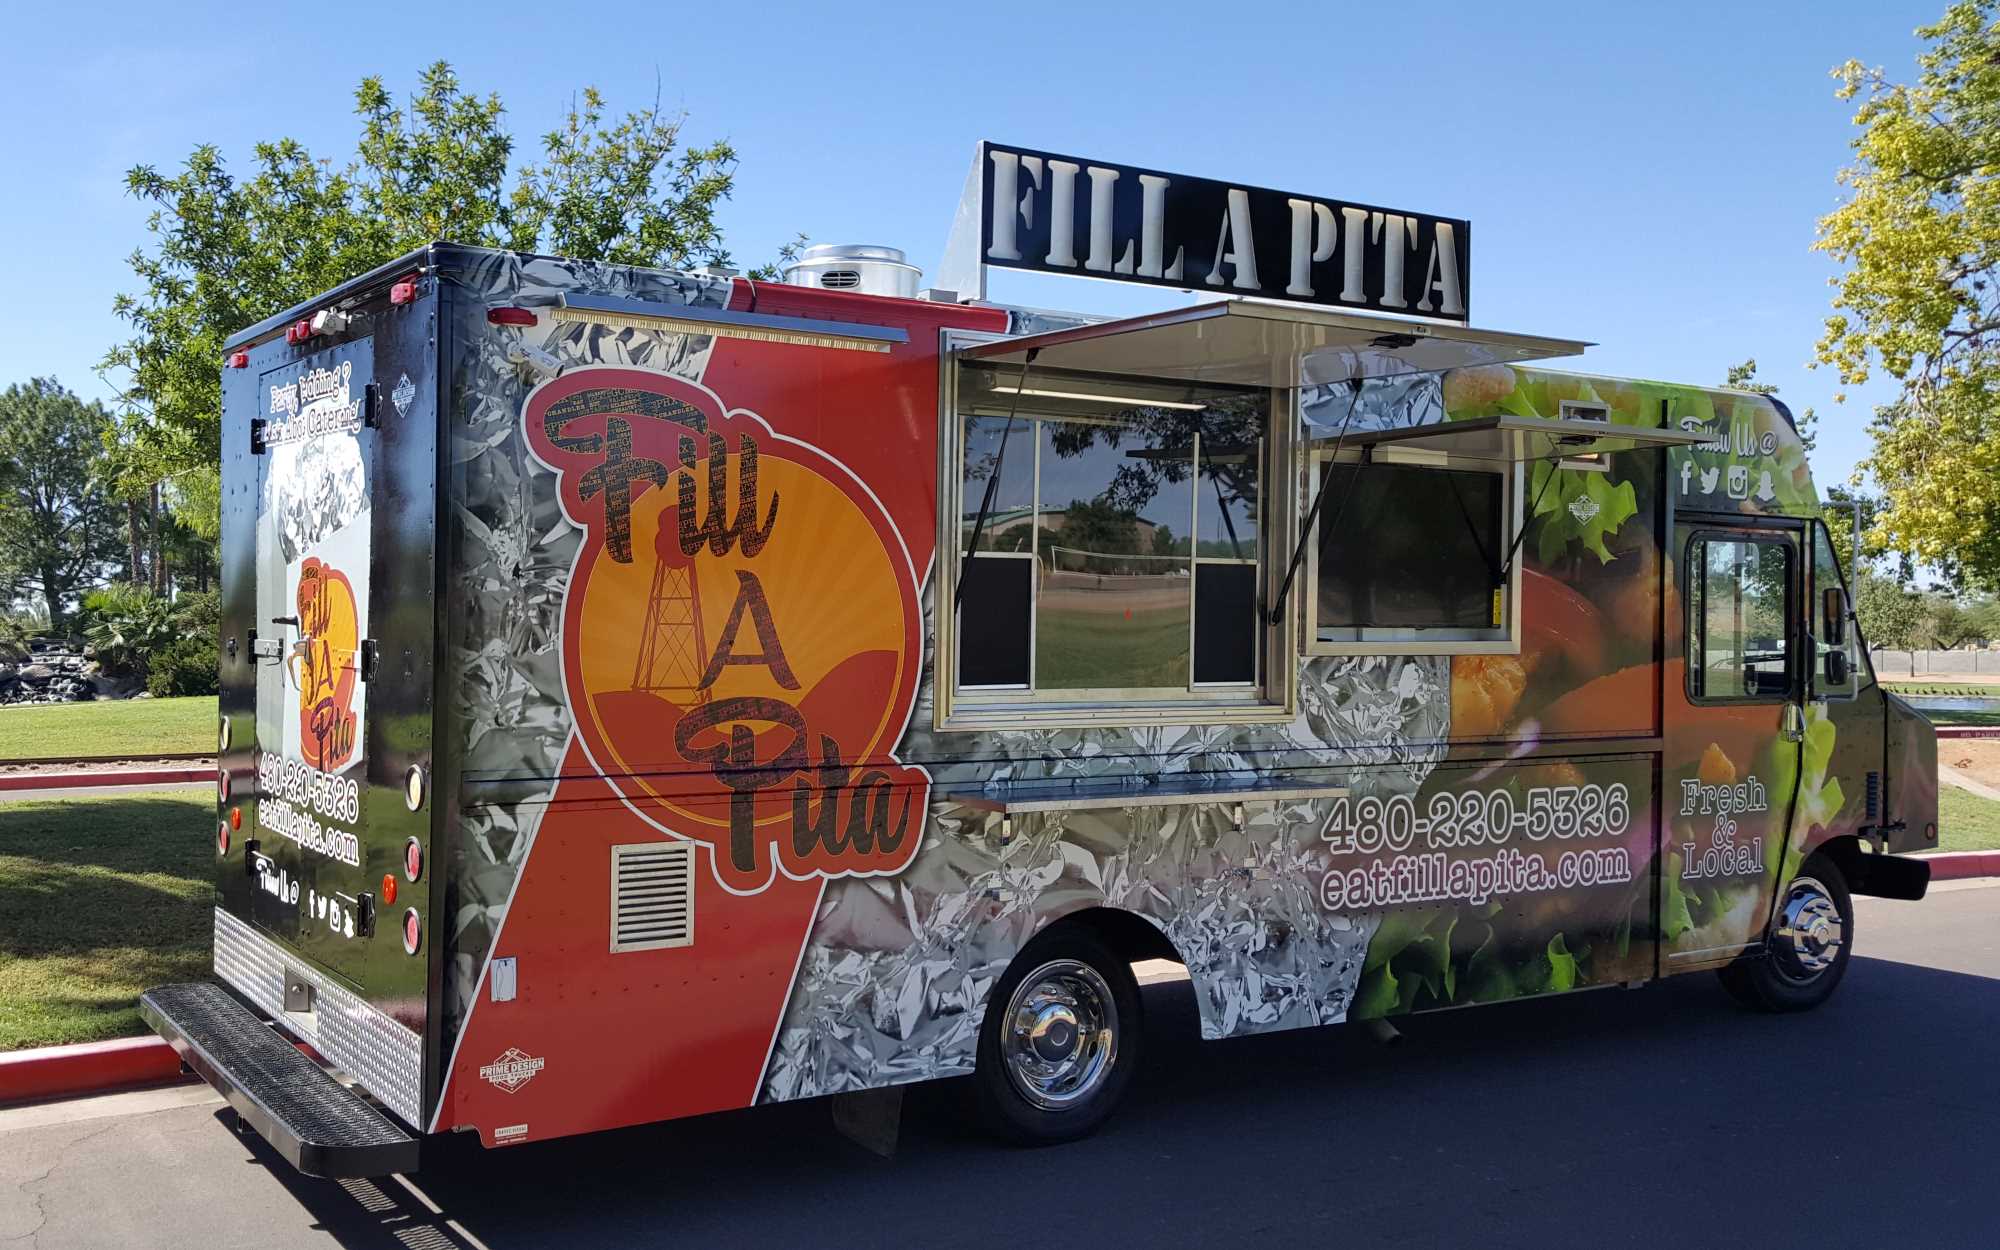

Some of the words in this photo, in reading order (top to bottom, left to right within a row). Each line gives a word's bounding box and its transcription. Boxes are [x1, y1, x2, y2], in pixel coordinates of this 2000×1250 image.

[987, 149, 1183, 281] FILL
[1205, 189, 1261, 290] A
[1285, 198, 1465, 314] PITA
[308, 399, 361, 434] Catering
[1736, 423, 1755, 456] Us
[1760, 431, 1777, 455] @
[543, 388, 779, 564] Fill
[695, 569, 802, 691] A
[259, 752, 359, 824] 480-220-5326
[673, 696, 912, 873] Pita
[1680, 775, 1768, 816] Fresh
[259, 798, 360, 867] eatfillapita.com
[1320, 783, 1630, 855] 480-220-5326
[1712, 813, 1736, 850] &
[1320, 846, 1632, 911] eatfillapita.com
[1682, 837, 1765, 880] Local
[480, 1064, 510, 1078] PRIME
[510, 1057, 545, 1073] DESIGN
